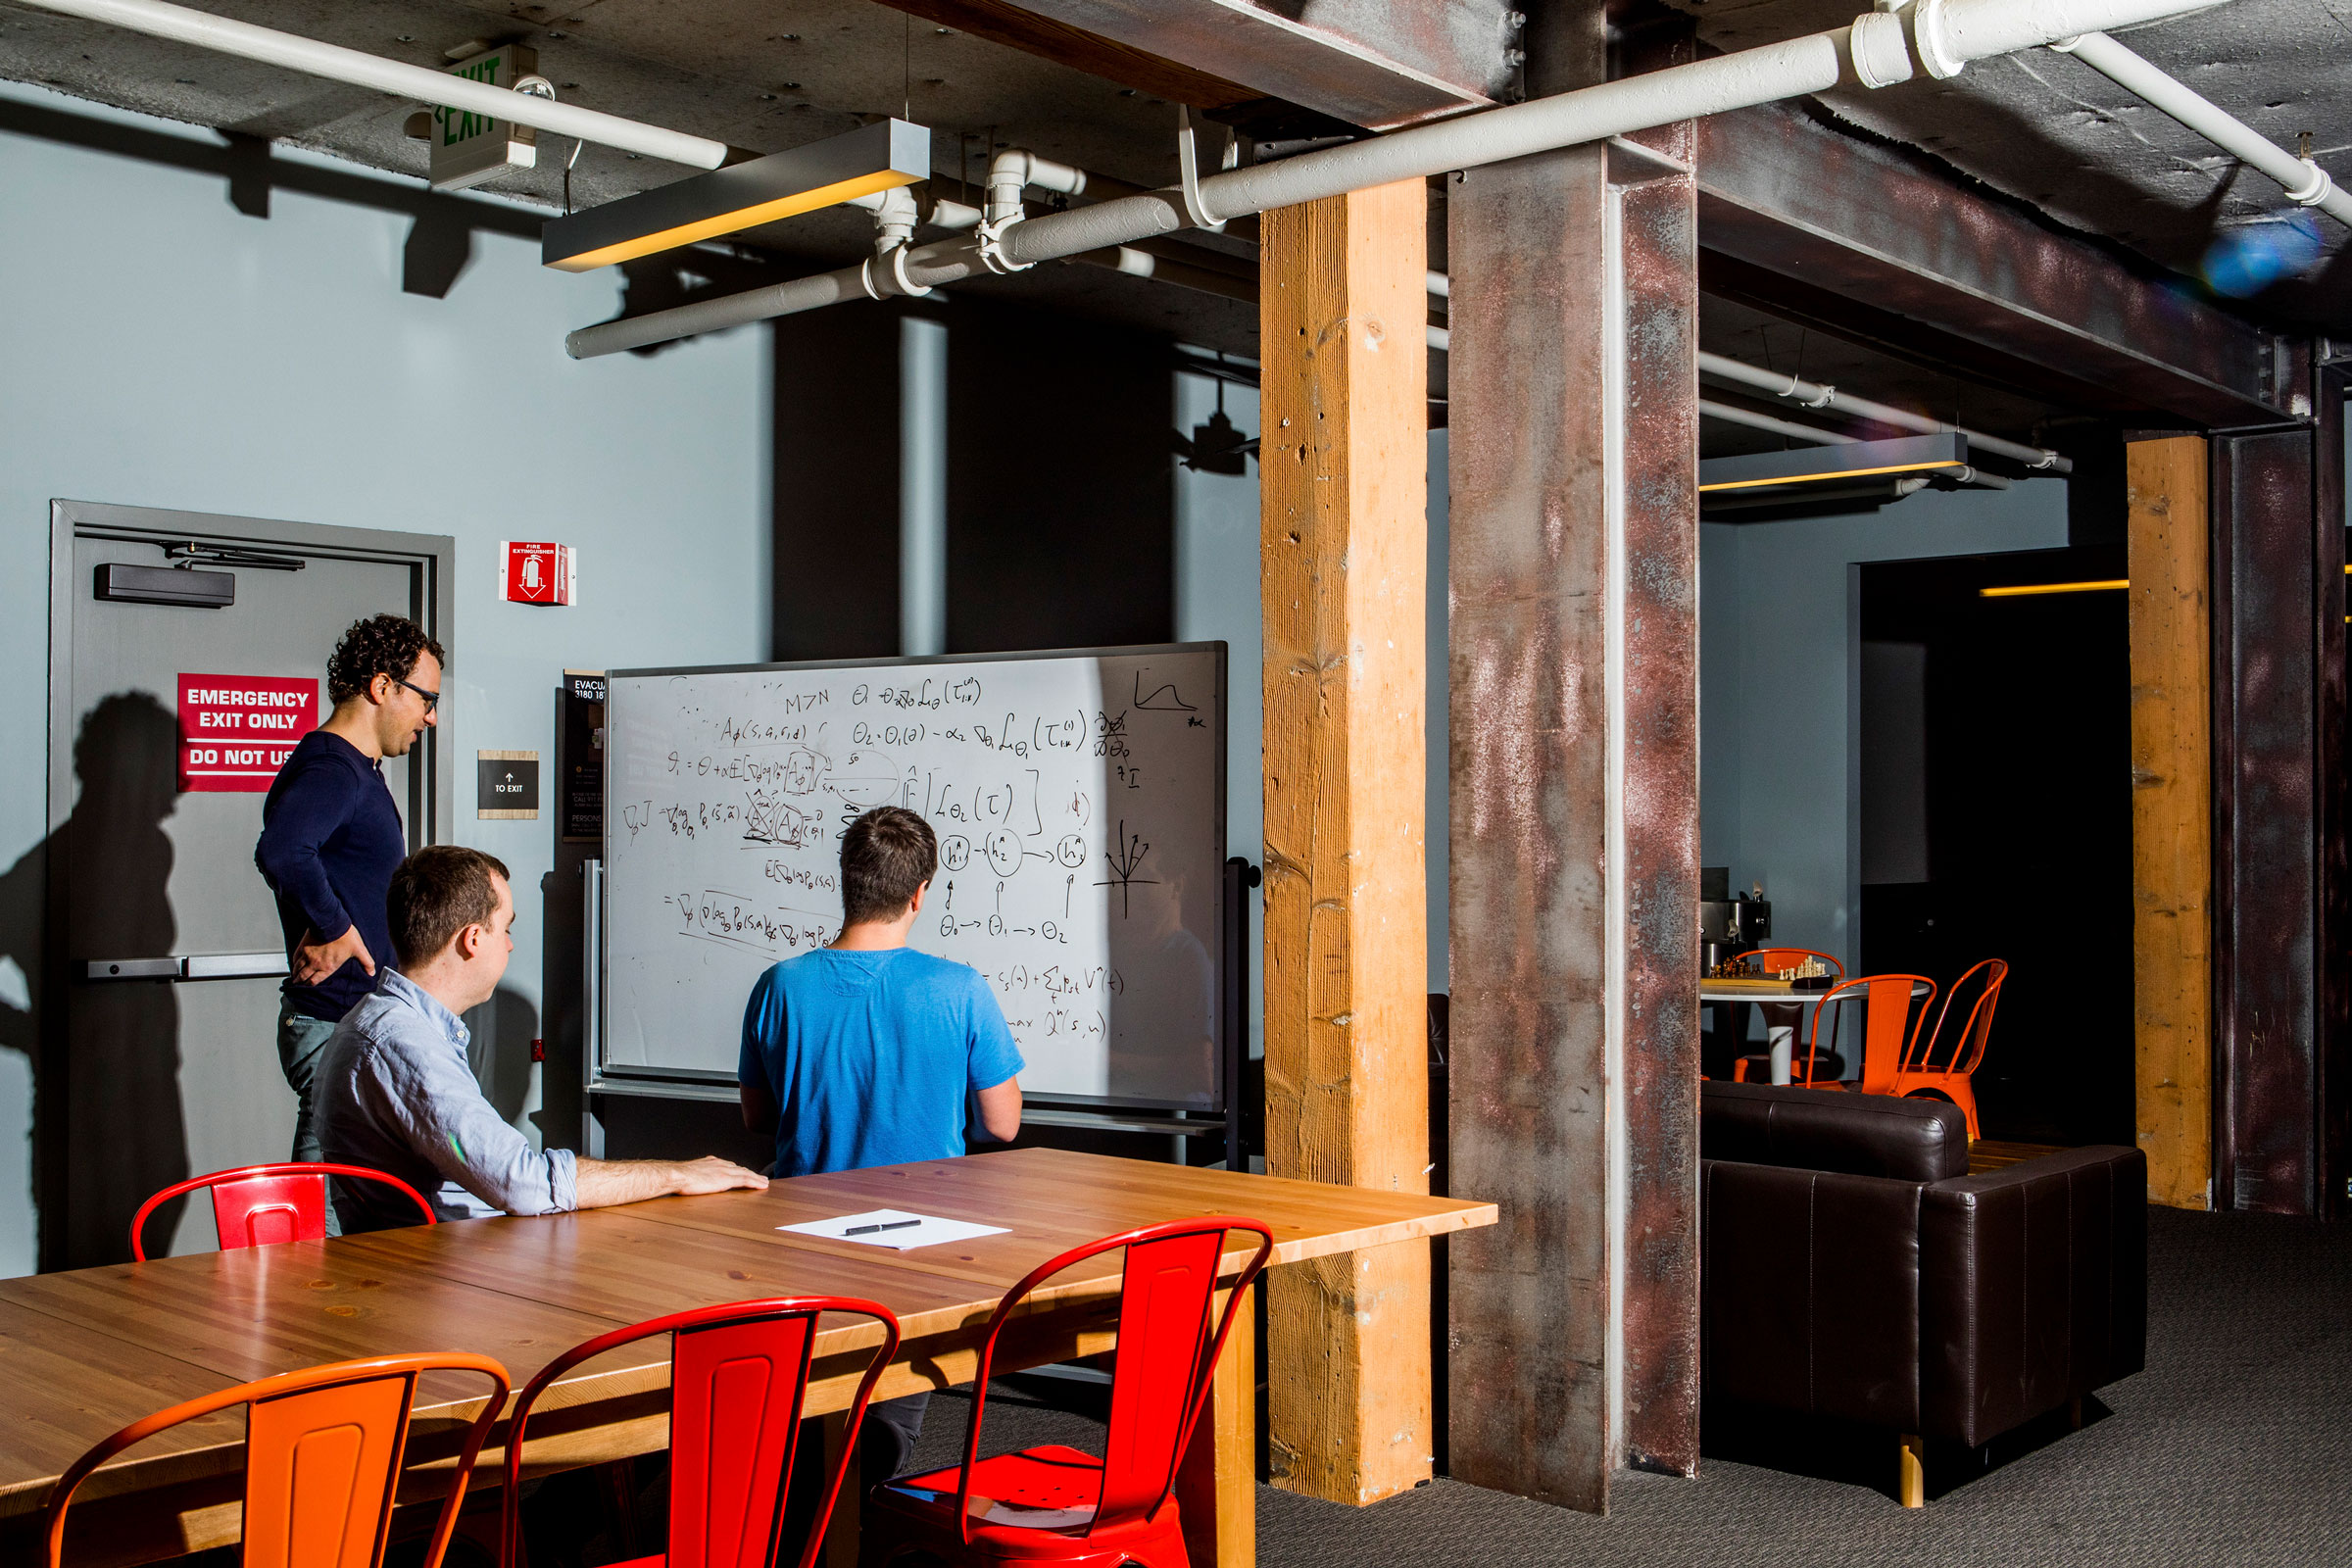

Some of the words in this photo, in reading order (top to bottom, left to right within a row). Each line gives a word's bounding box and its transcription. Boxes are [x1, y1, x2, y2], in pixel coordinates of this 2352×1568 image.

[574, 680, 605, 690] EVACU
[187, 688, 310, 708] EMERGENCY
[574, 690, 593, 699] 3180
[199, 711, 243, 728] EXIT
[248, 713, 298, 729] ONLY
[189, 749, 218, 764] DO
[224, 750, 265, 765] NOT
[495, 784, 506, 793] TO
[507, 784, 523, 793] EXIT
